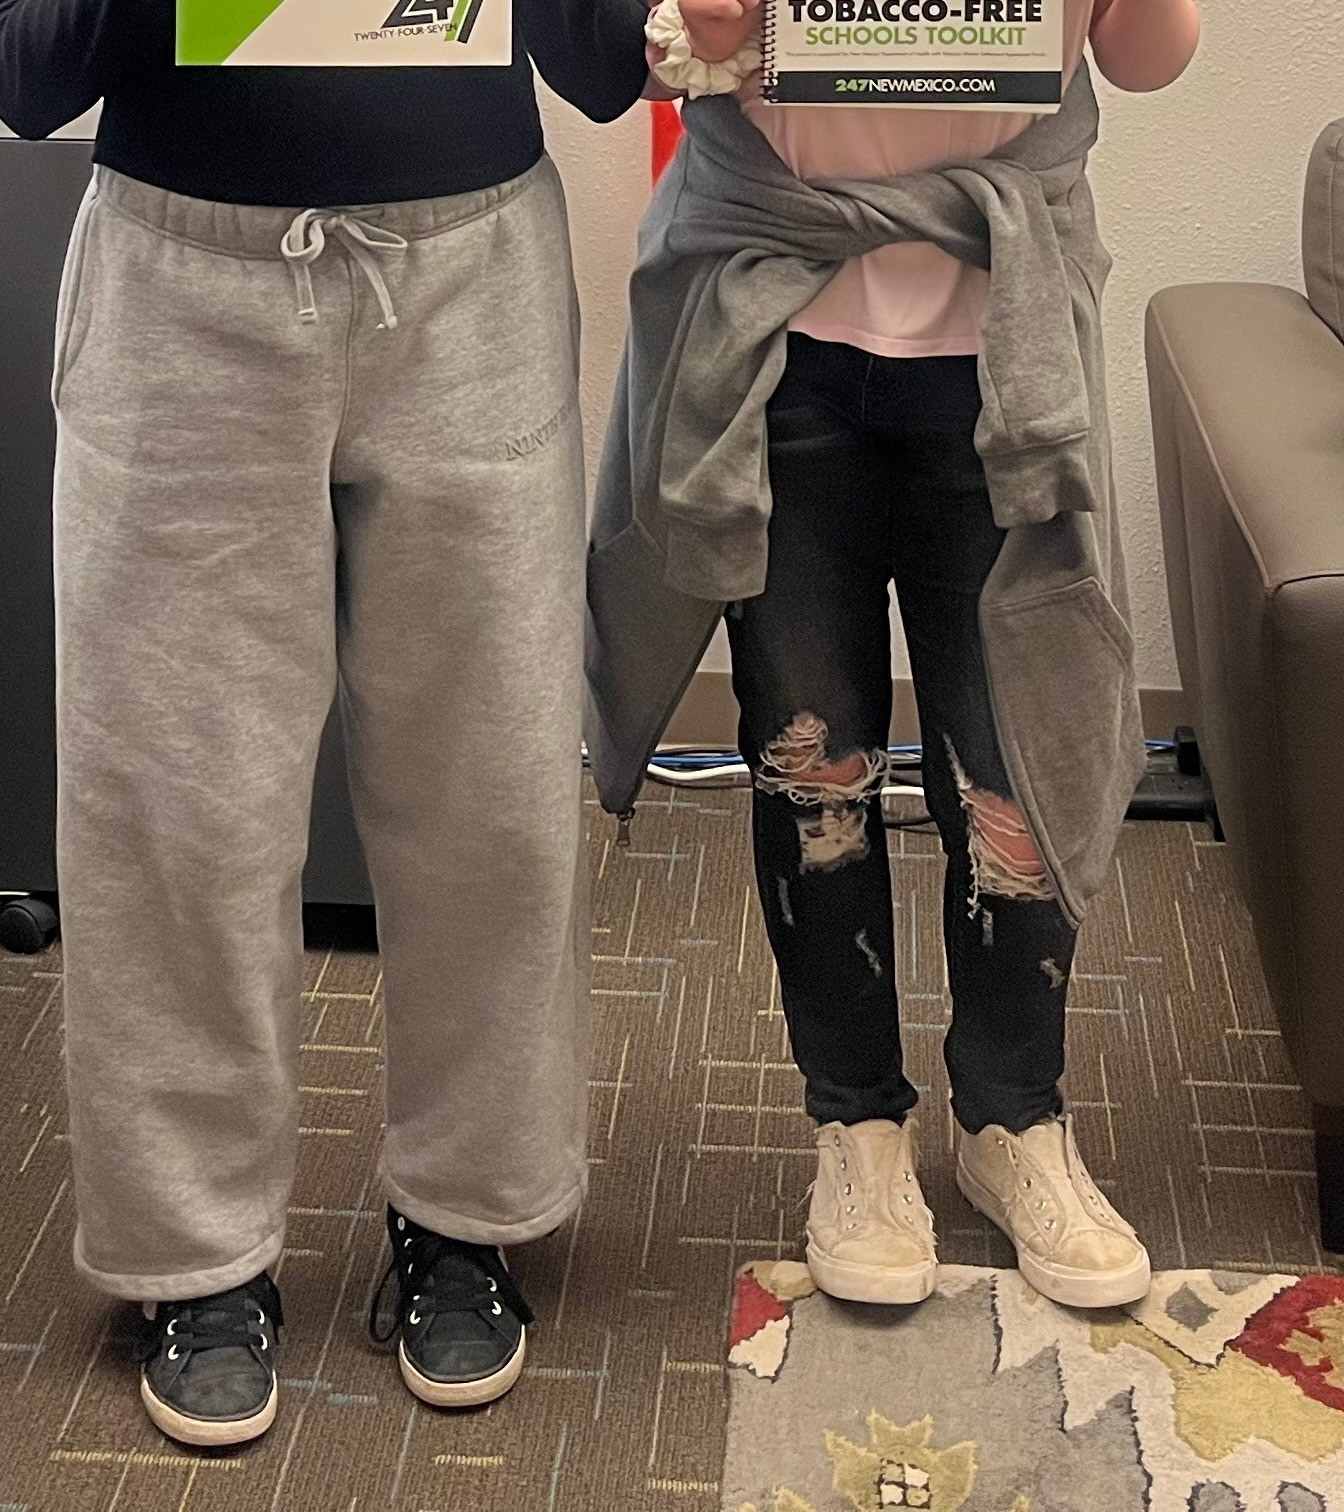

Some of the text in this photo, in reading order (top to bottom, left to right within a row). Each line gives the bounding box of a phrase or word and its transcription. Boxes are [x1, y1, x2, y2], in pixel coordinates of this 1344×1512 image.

[354, 29, 395, 41] TWENTY
[806, 26, 1027, 45] SCHOOLS TOOLKIT
[835, 78, 996, 92] 247NEWMEXICO.COM
